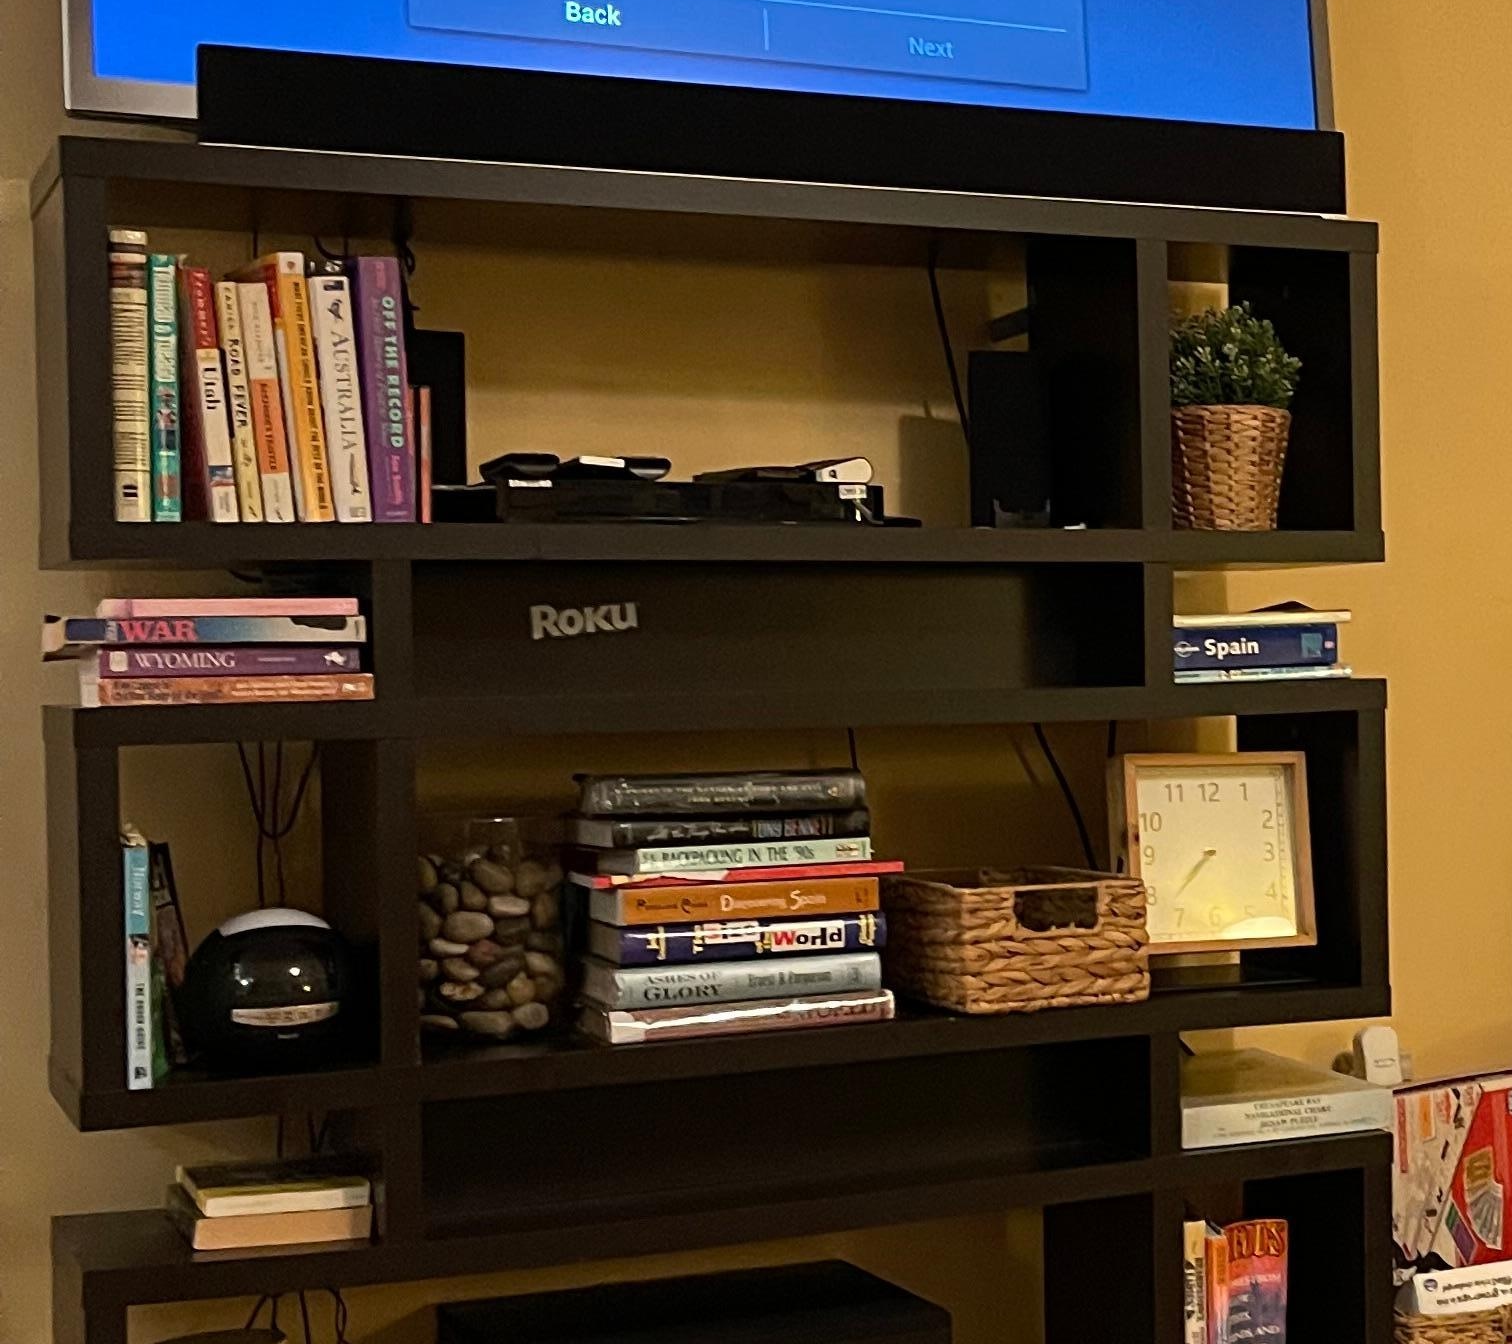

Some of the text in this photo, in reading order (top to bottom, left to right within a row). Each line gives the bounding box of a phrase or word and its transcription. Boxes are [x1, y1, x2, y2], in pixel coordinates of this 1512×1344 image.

[565, 0, 622, 26] Back
[909, 37, 954, 59] Next
[228, 337, 242, 376] ROAD
[381, 296, 404, 447] OFF THE RECORD
[203, 367, 222, 411] Utah
[331, 331, 358, 450] AUSTRALIA
[233, 384, 249, 429] FEVER
[118, 620, 198, 641] WAR
[1204, 637, 1260, 660] Spain
[134, 651, 236, 669] WYOMING
[1165, 783, 1184, 802] 11
[1198, 782, 1220, 802] 12
[1239, 782, 1249, 801] 1
[1140, 811, 1162, 832] 10
[1262, 809, 1274, 829] 2
[662, 848, 744, 867] BACKPACKING
[748, 847, 762, 862] IN
[767, 846, 788, 862] THE
[1143, 845, 1155, 866] 9
[1263, 842, 1275, 862] 3
[1146, 886, 1157, 906] 8
[1265, 882, 1278, 899] 4
[1174, 908, 1185, 928] 7
[1209, 906, 1222, 927] 6
[774, 927, 843, 947] World
[644, 983, 722, 1002] GLORY
